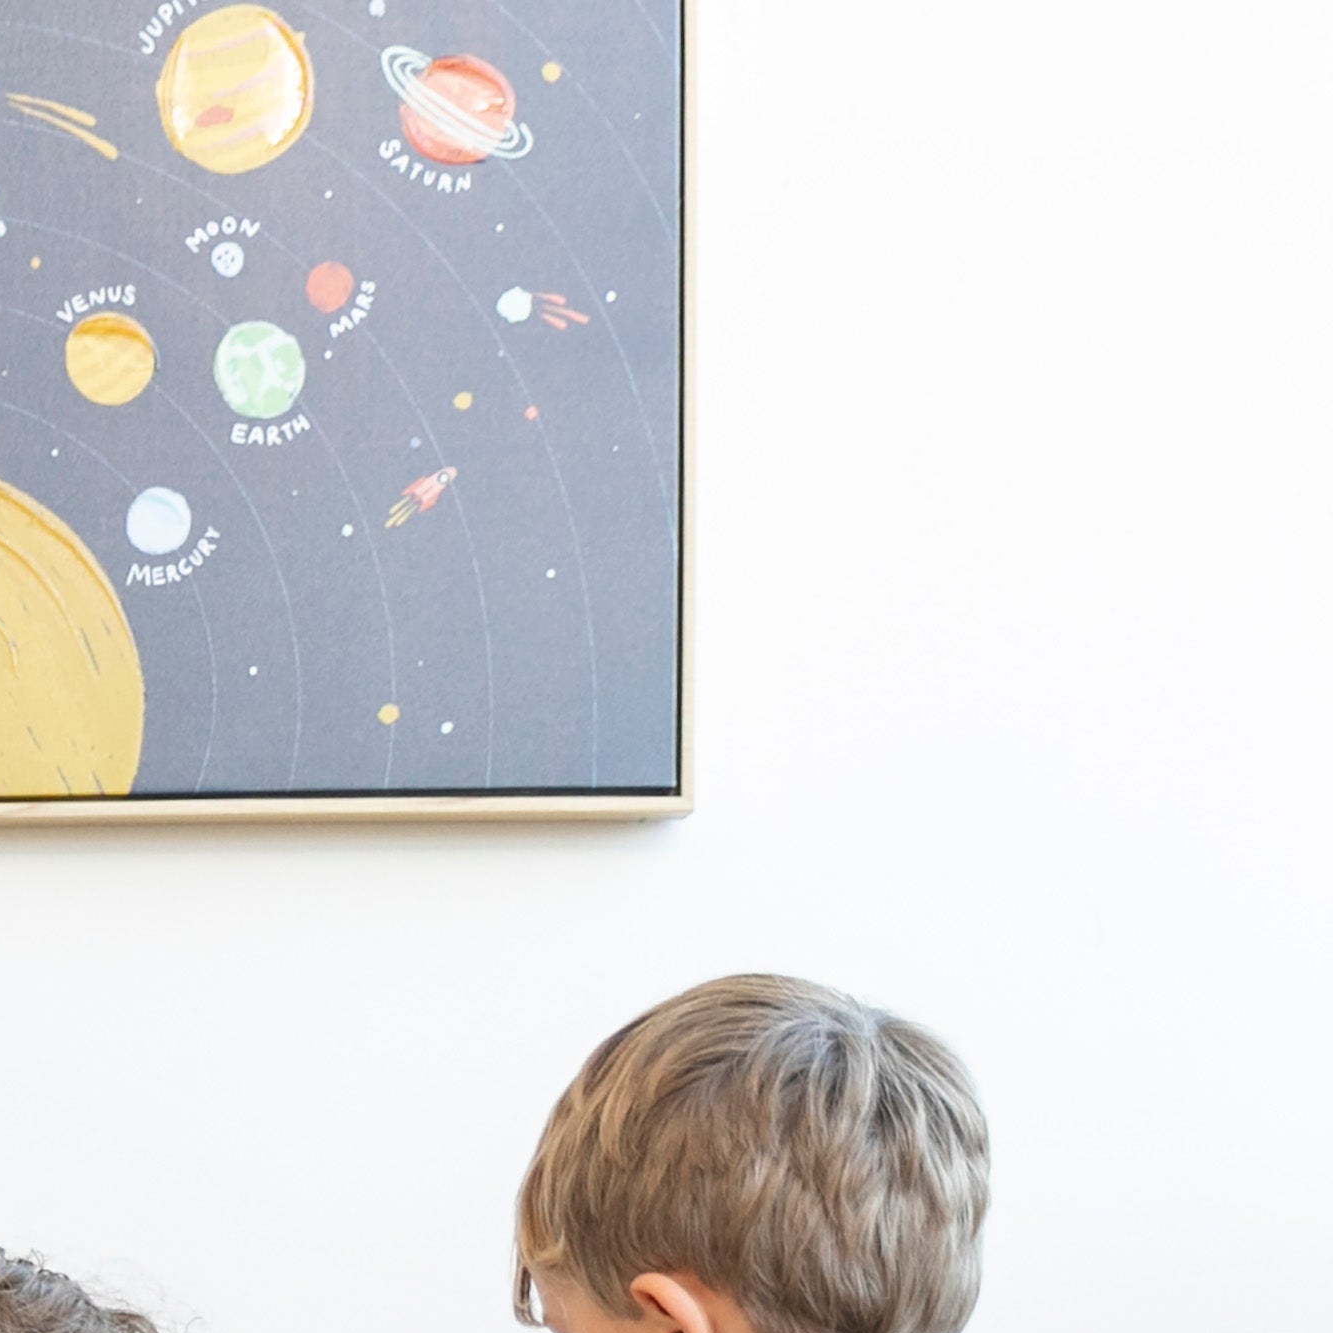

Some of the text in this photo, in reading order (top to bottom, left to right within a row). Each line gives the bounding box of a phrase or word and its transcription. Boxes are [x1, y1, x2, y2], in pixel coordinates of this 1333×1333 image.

[137, 0, 197, 55] JUPI
[378, 138, 473, 194] SATURN
[184, 215, 261, 254] MOON
[56, 283, 137, 324] VENUS
[328, 279, 377, 338] MARS
[229, 413, 312, 447] EARTH
[125, 525, 221, 587] MERCURY
